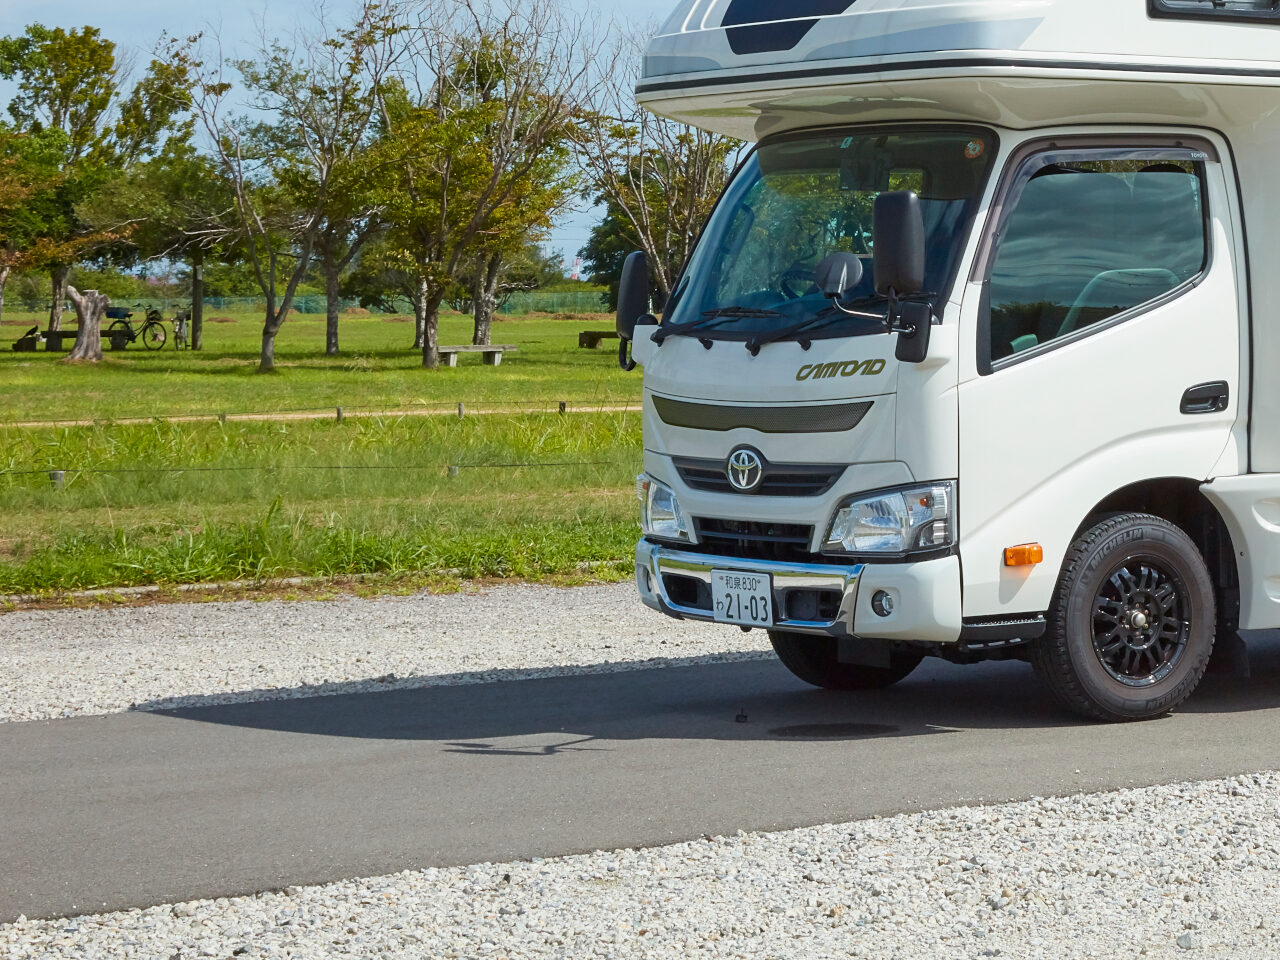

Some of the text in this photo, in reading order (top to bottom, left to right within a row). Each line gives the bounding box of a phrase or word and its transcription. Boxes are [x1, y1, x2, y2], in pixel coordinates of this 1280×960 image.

[1090, 527, 1144, 570] MICHELIN
[716, 597, 724, 611] わ
[725, 592, 769, 622] 21-03
